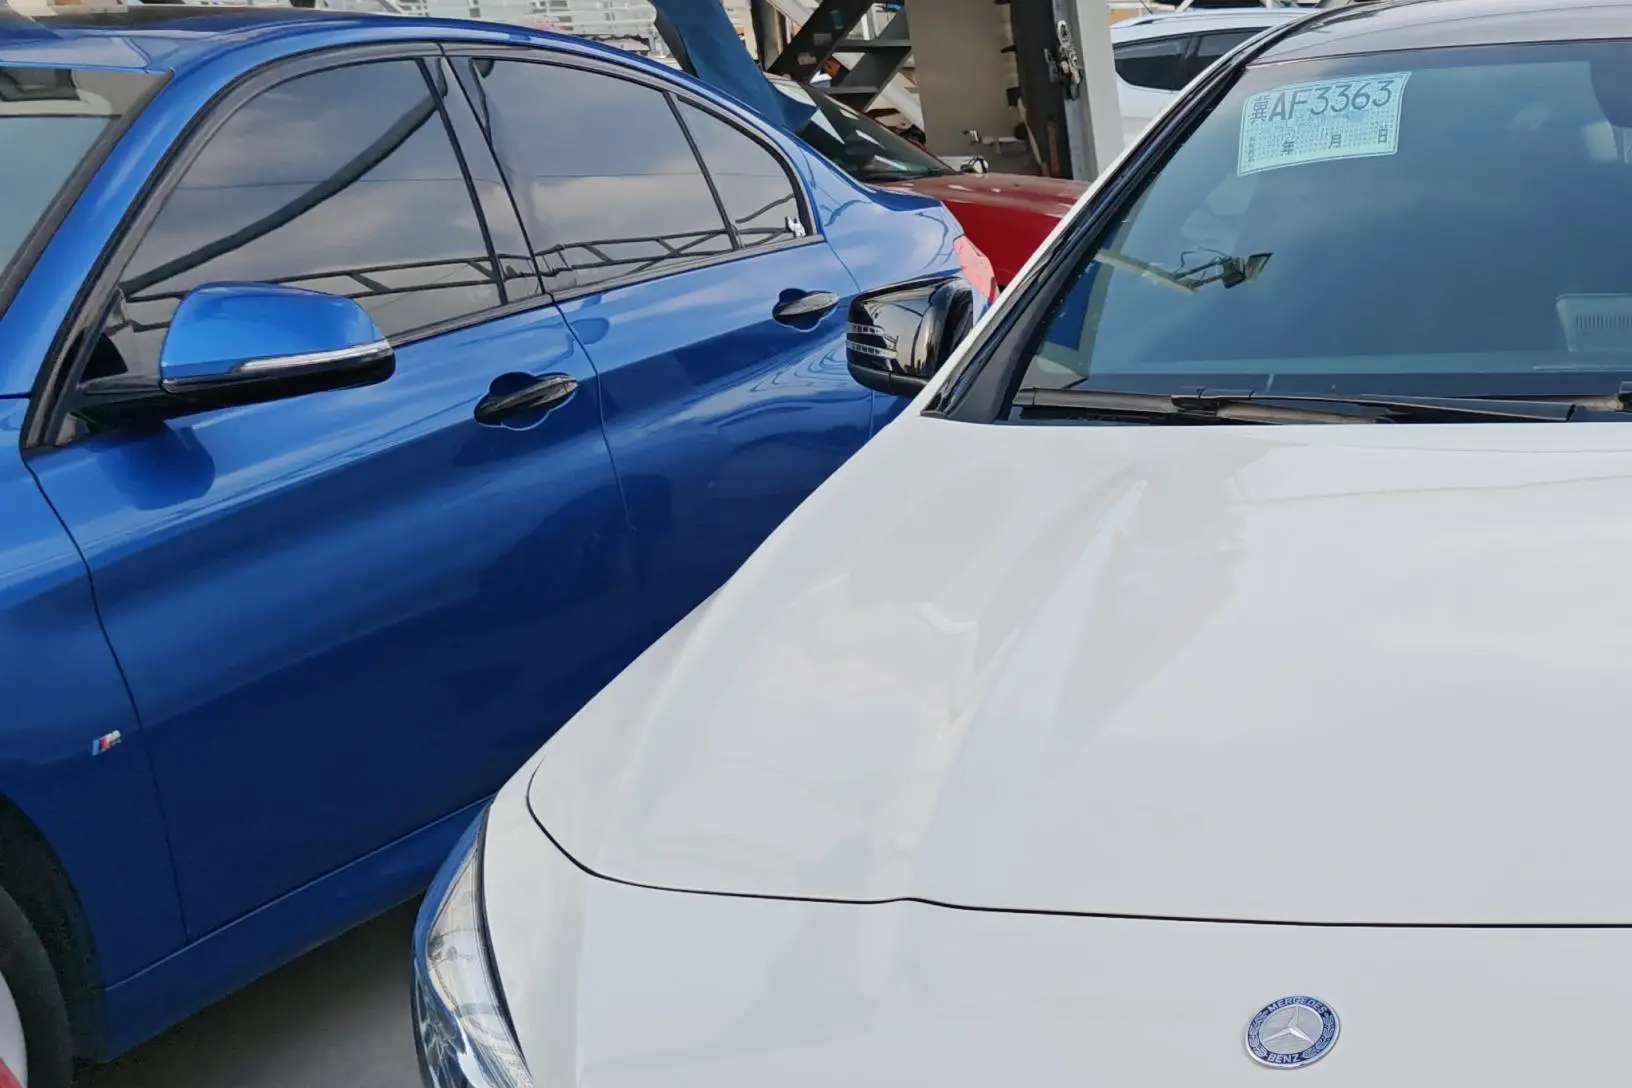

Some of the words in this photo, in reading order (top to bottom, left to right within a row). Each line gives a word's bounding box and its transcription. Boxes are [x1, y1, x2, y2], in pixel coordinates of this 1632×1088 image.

[1280, 140, 1295, 156] 年
[1328, 134, 1342, 150] 月
[1377, 128, 1389, 144] 日
[1267, 997, 1327, 1014] MERCEDES
[1267, 1053, 1301, 1064] BENZ
